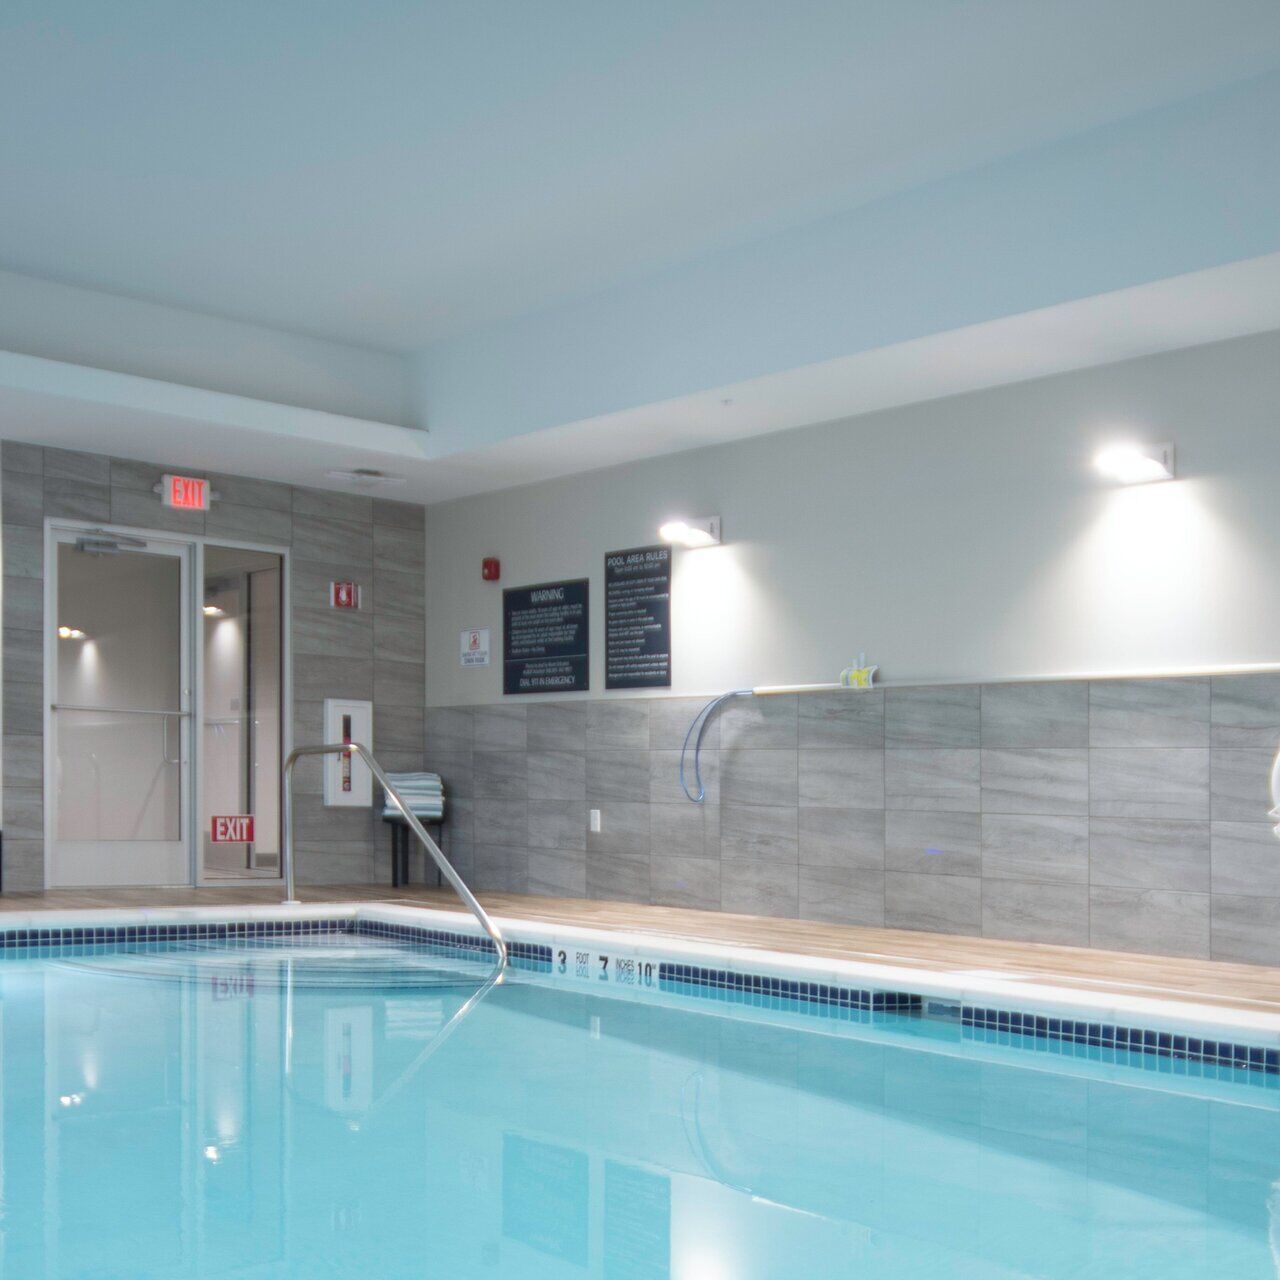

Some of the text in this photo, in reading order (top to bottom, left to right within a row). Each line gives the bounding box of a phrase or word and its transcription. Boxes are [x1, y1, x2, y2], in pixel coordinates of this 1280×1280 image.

[172, 476, 206, 508] EXIT
[608, 550, 668, 566] POOL AREA RULES
[530, 587, 564, 602] WARNING
[216, 817, 249, 840] EXIT
[576, 952, 590, 965] FOOT
